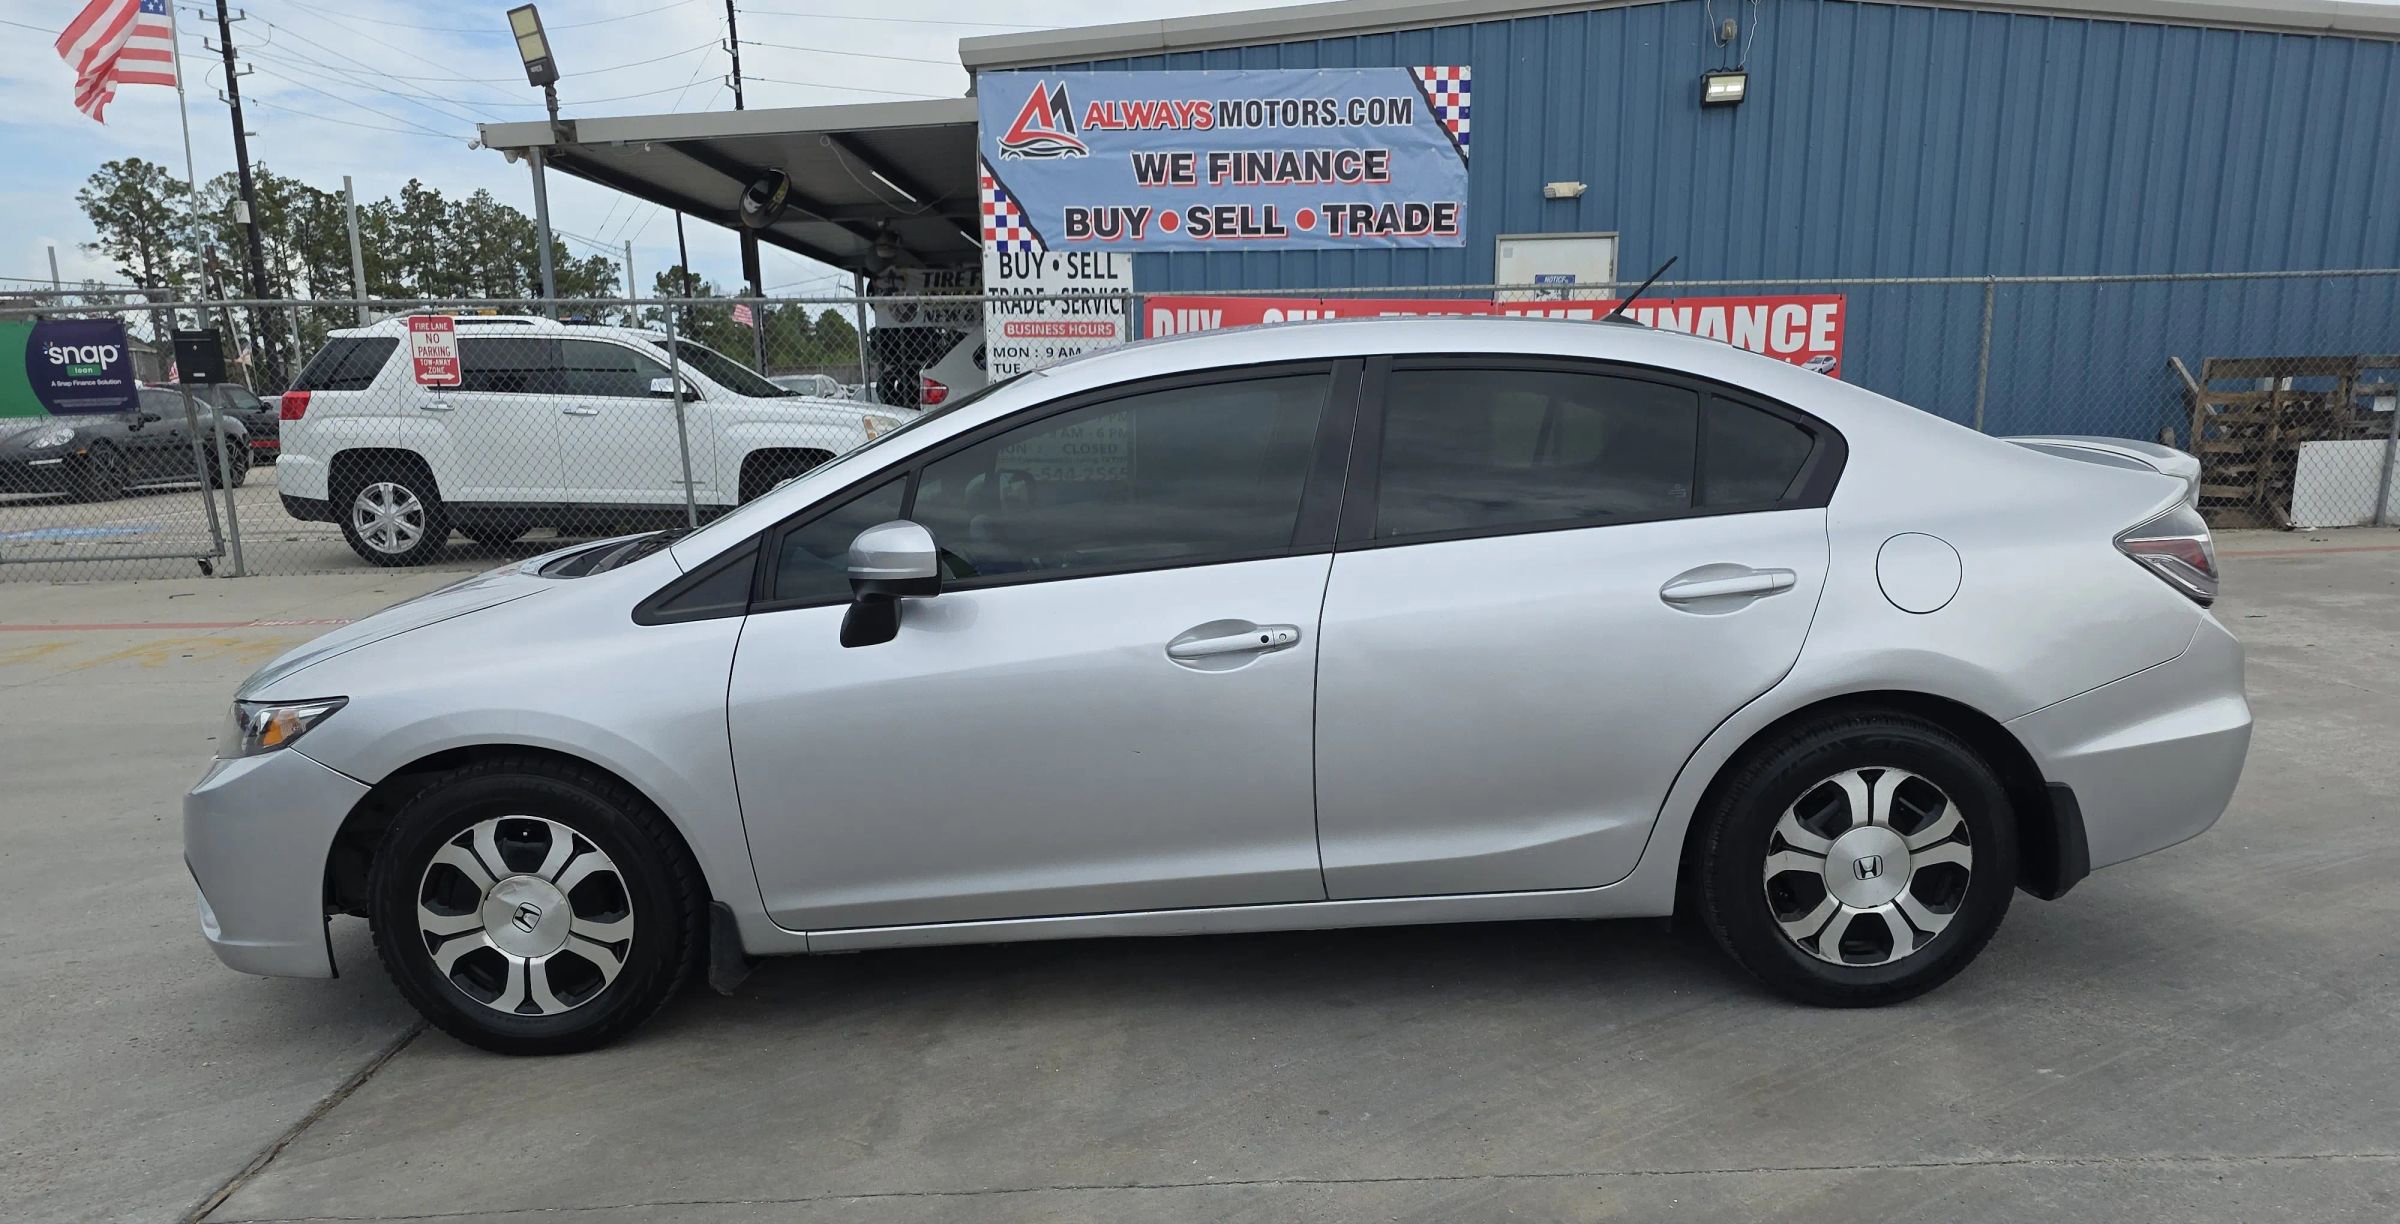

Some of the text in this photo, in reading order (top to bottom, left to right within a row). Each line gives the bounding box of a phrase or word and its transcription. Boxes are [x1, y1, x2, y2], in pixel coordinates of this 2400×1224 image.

[1131, 150, 1391, 187] WE FINANCE
[1064, 202, 1462, 240] BUY SELL TRADE
[1000, 252, 1118, 279] BUY SELL
[922, 272, 964, 287] TIRE
[989, 288, 1044, 315] TRADE
[415, 322, 448, 331] FIRE LANE
[1007, 324, 1112, 335] BUSINESS HOURS
[1610, 304, 1838, 353] NANCE
[425, 333, 440, 344] NO
[48, 345, 118, 370] snap
[418, 346, 450, 357] PARKING
[993, 347, 1029, 358] MON
[1046, 347, 1054, 359] 9
[1058, 347, 1081, 358] AM
[994, 363, 1021, 374] TUE
